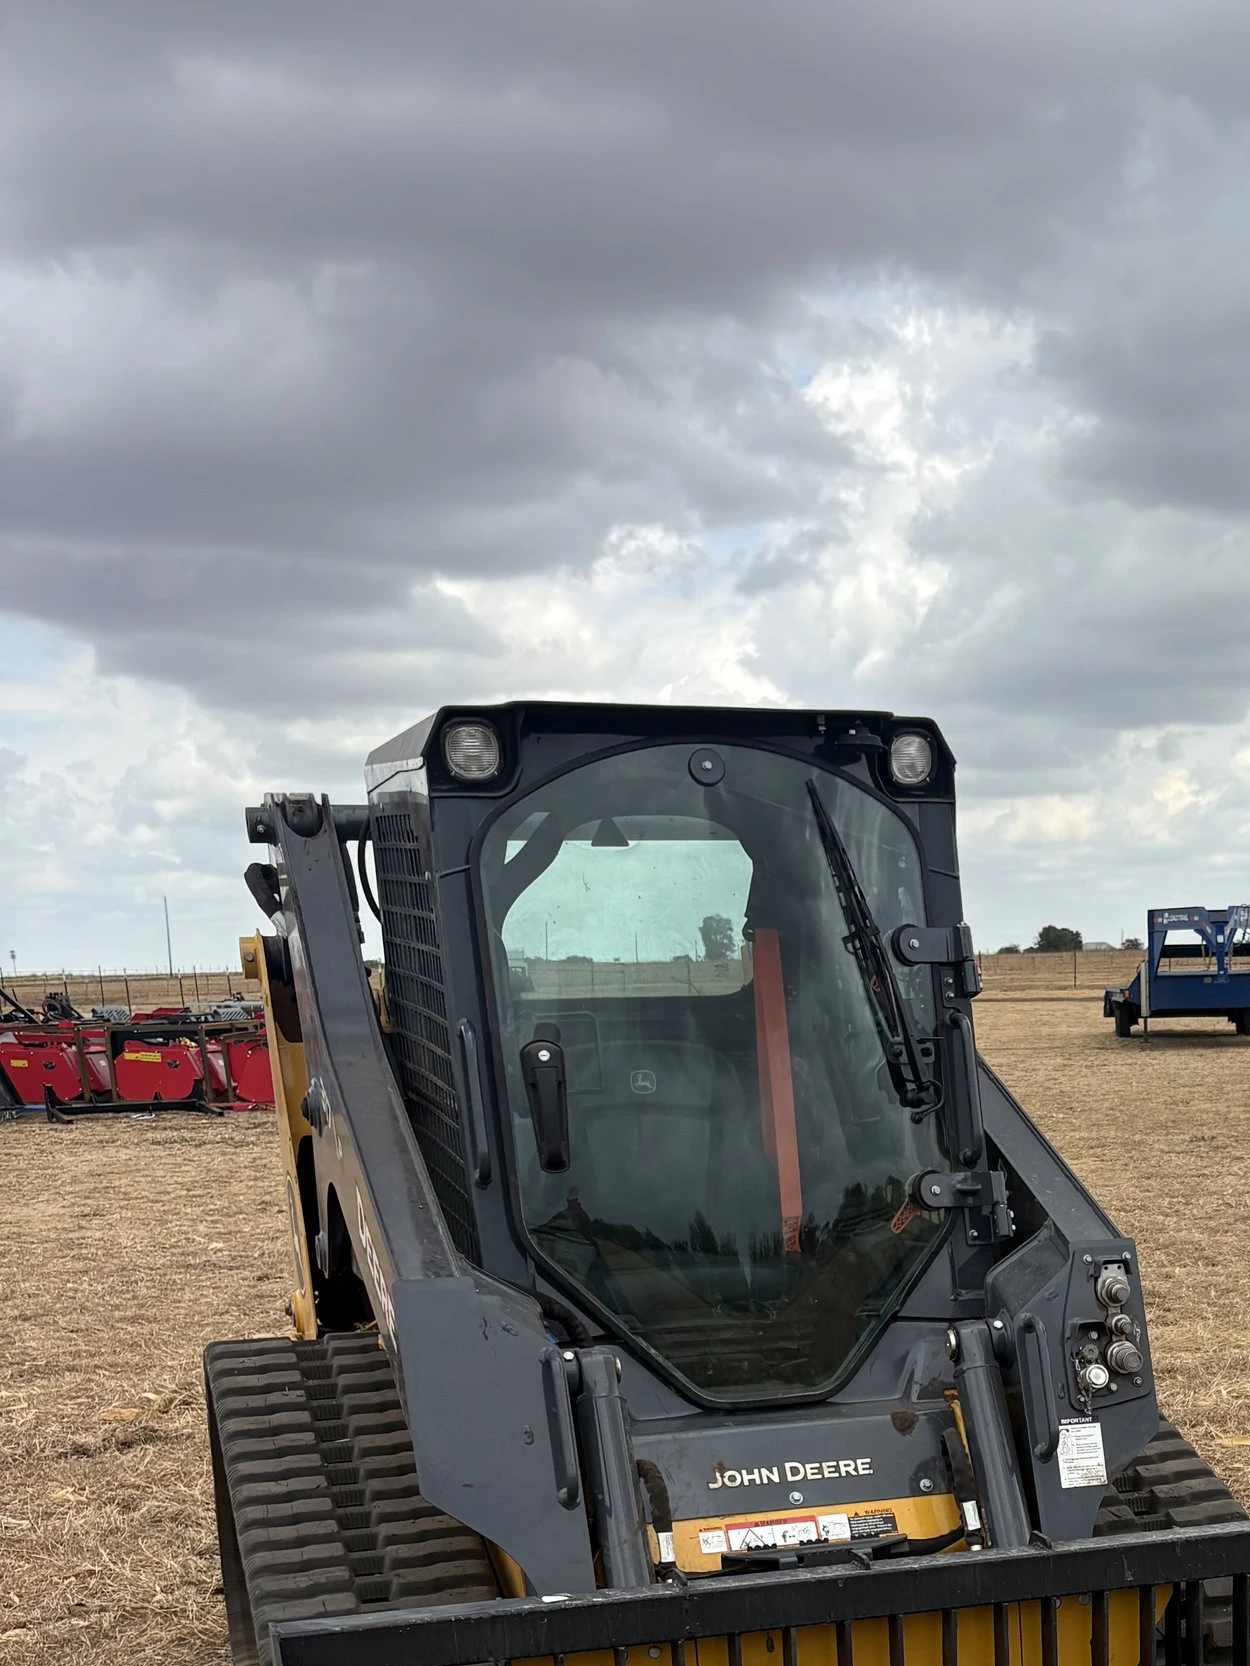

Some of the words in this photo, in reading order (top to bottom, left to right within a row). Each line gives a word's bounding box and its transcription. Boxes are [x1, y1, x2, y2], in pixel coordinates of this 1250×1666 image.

[1060, 1416, 1093, 1425] IMPORTANT
[708, 1466, 781, 1490] JOHN
[784, 1457, 874, 1482] DEERE
